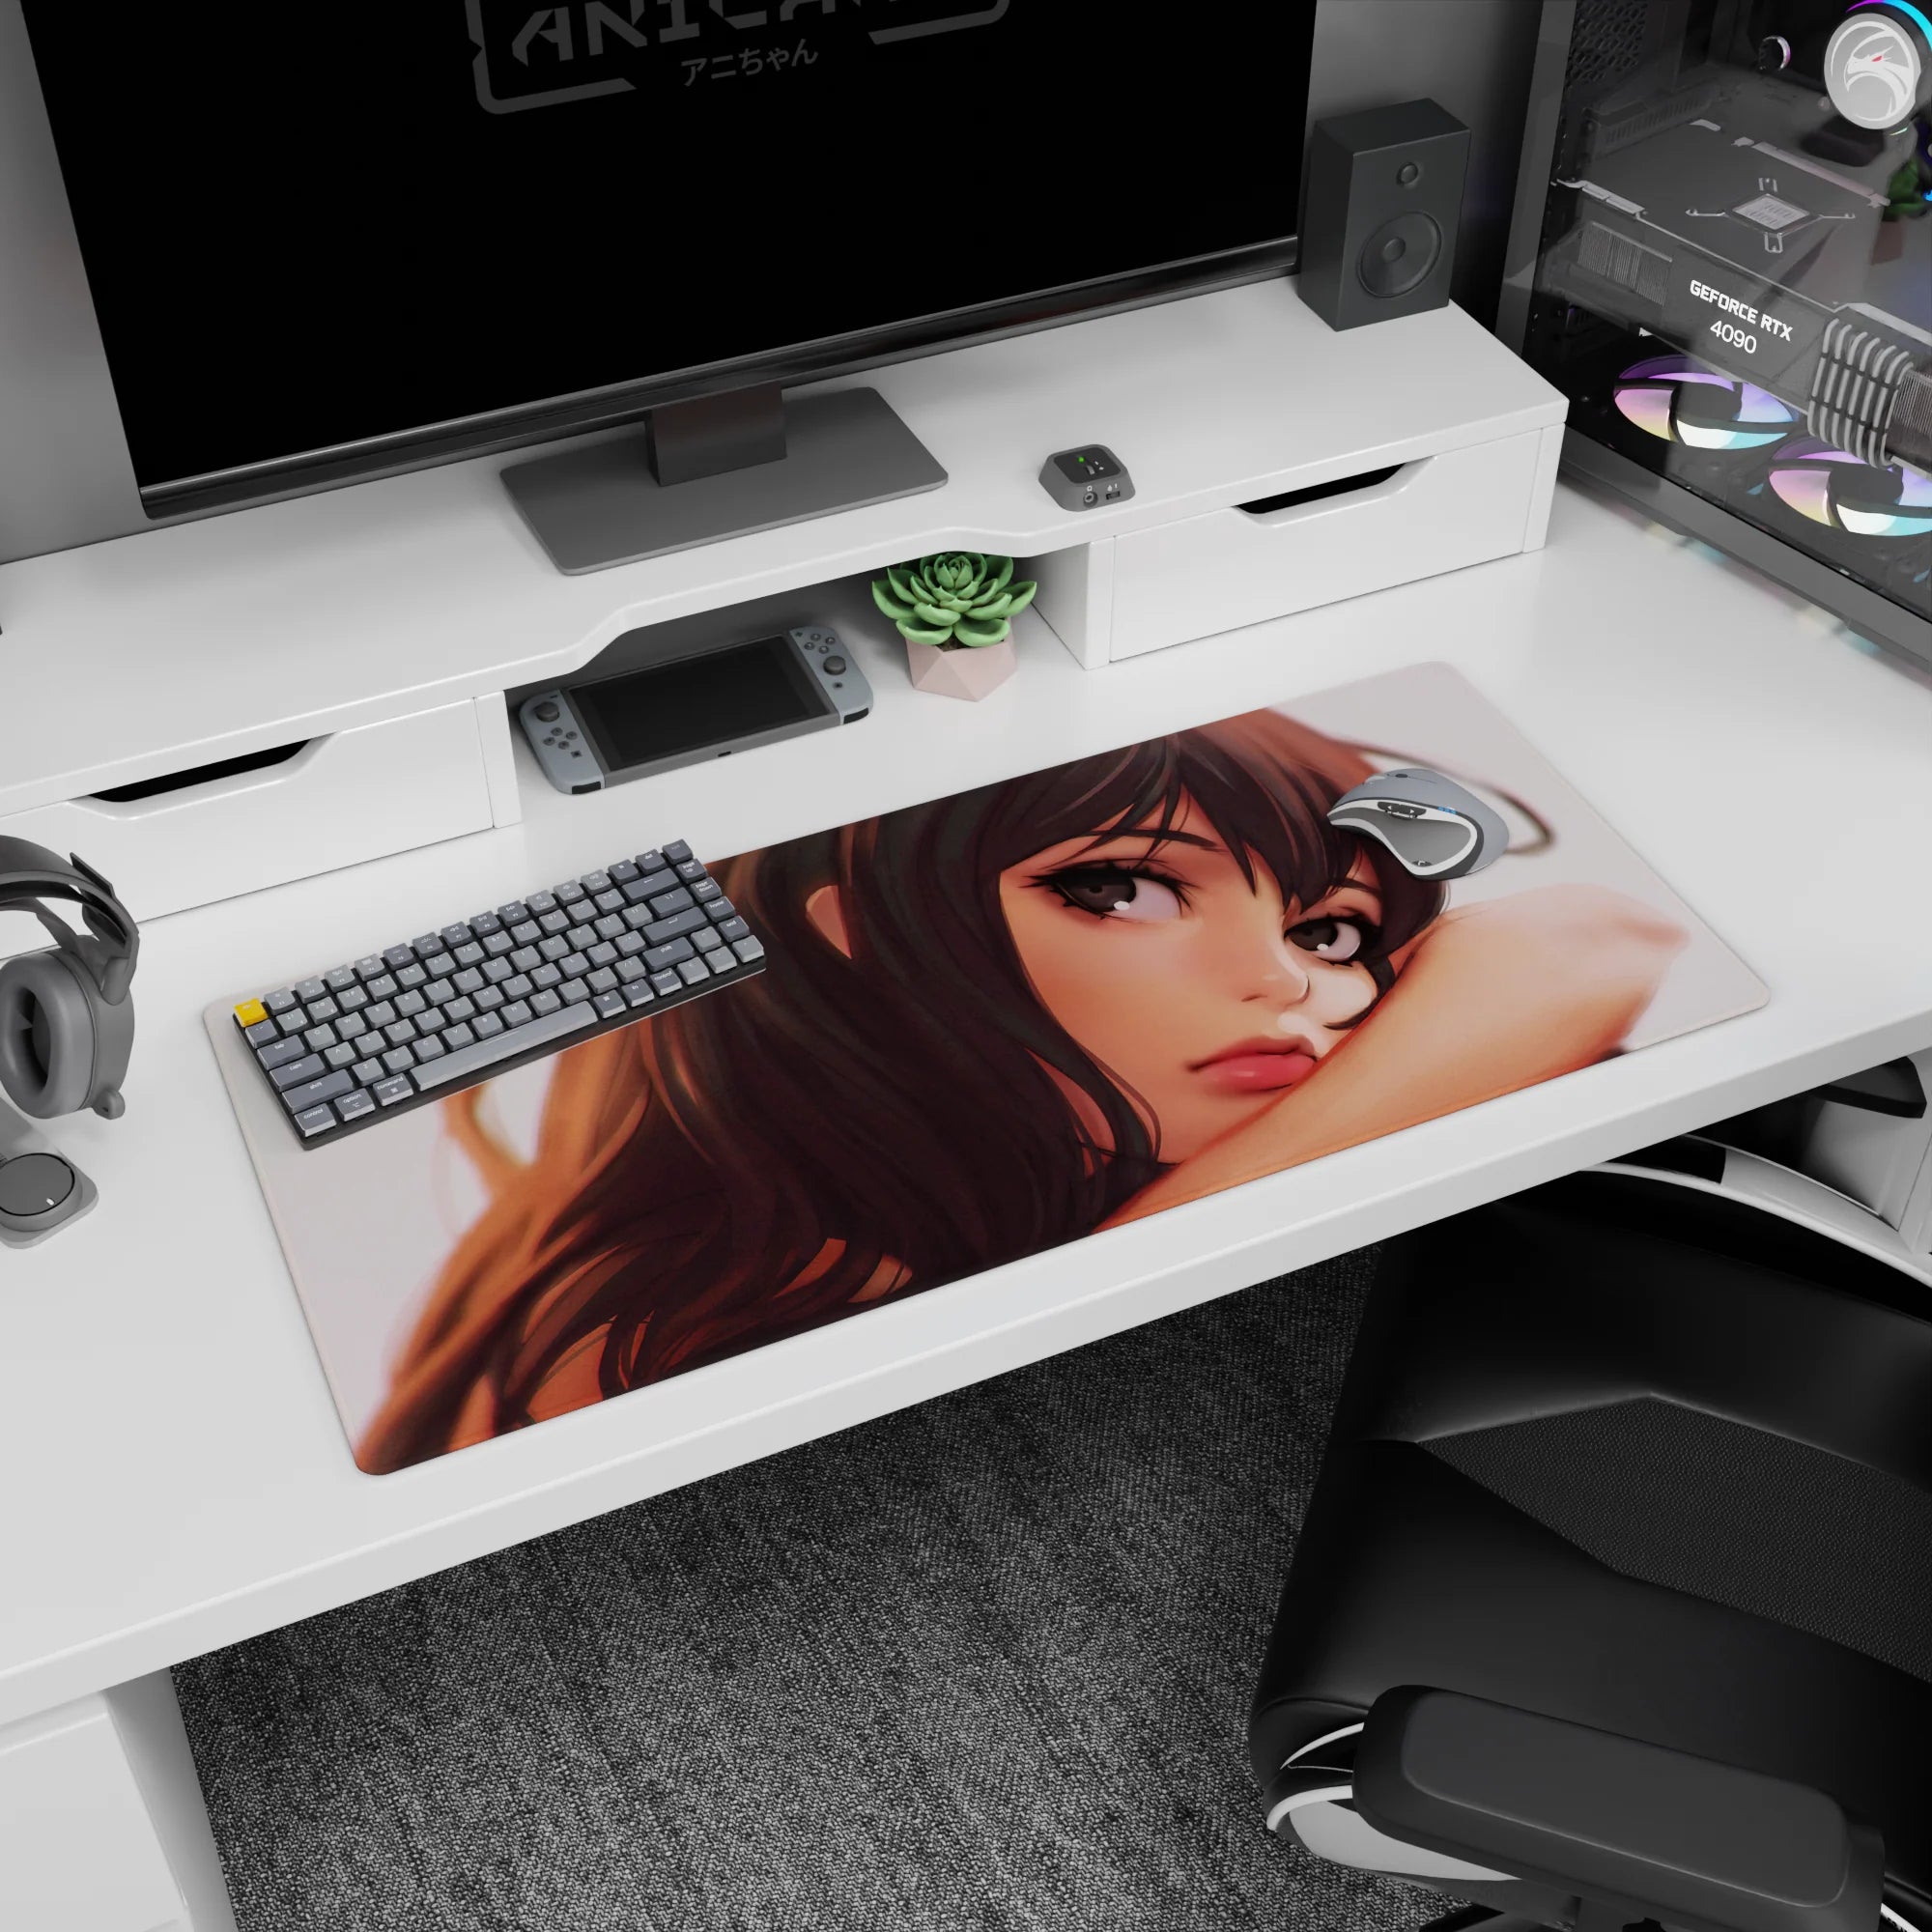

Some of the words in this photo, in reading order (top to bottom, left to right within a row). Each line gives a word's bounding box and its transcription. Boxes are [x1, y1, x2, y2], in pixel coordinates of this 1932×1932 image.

[682, 39, 818, 87] アニちゃん
[1690, 279, 1758, 324] GEFORCE
[1760, 313, 1794, 342] RTX
[1710, 320, 1756, 355] 4090
[377, 1074, 405, 1091] command
[342, 1094, 363, 1105] option
[303, 1108, 325, 1120] control
